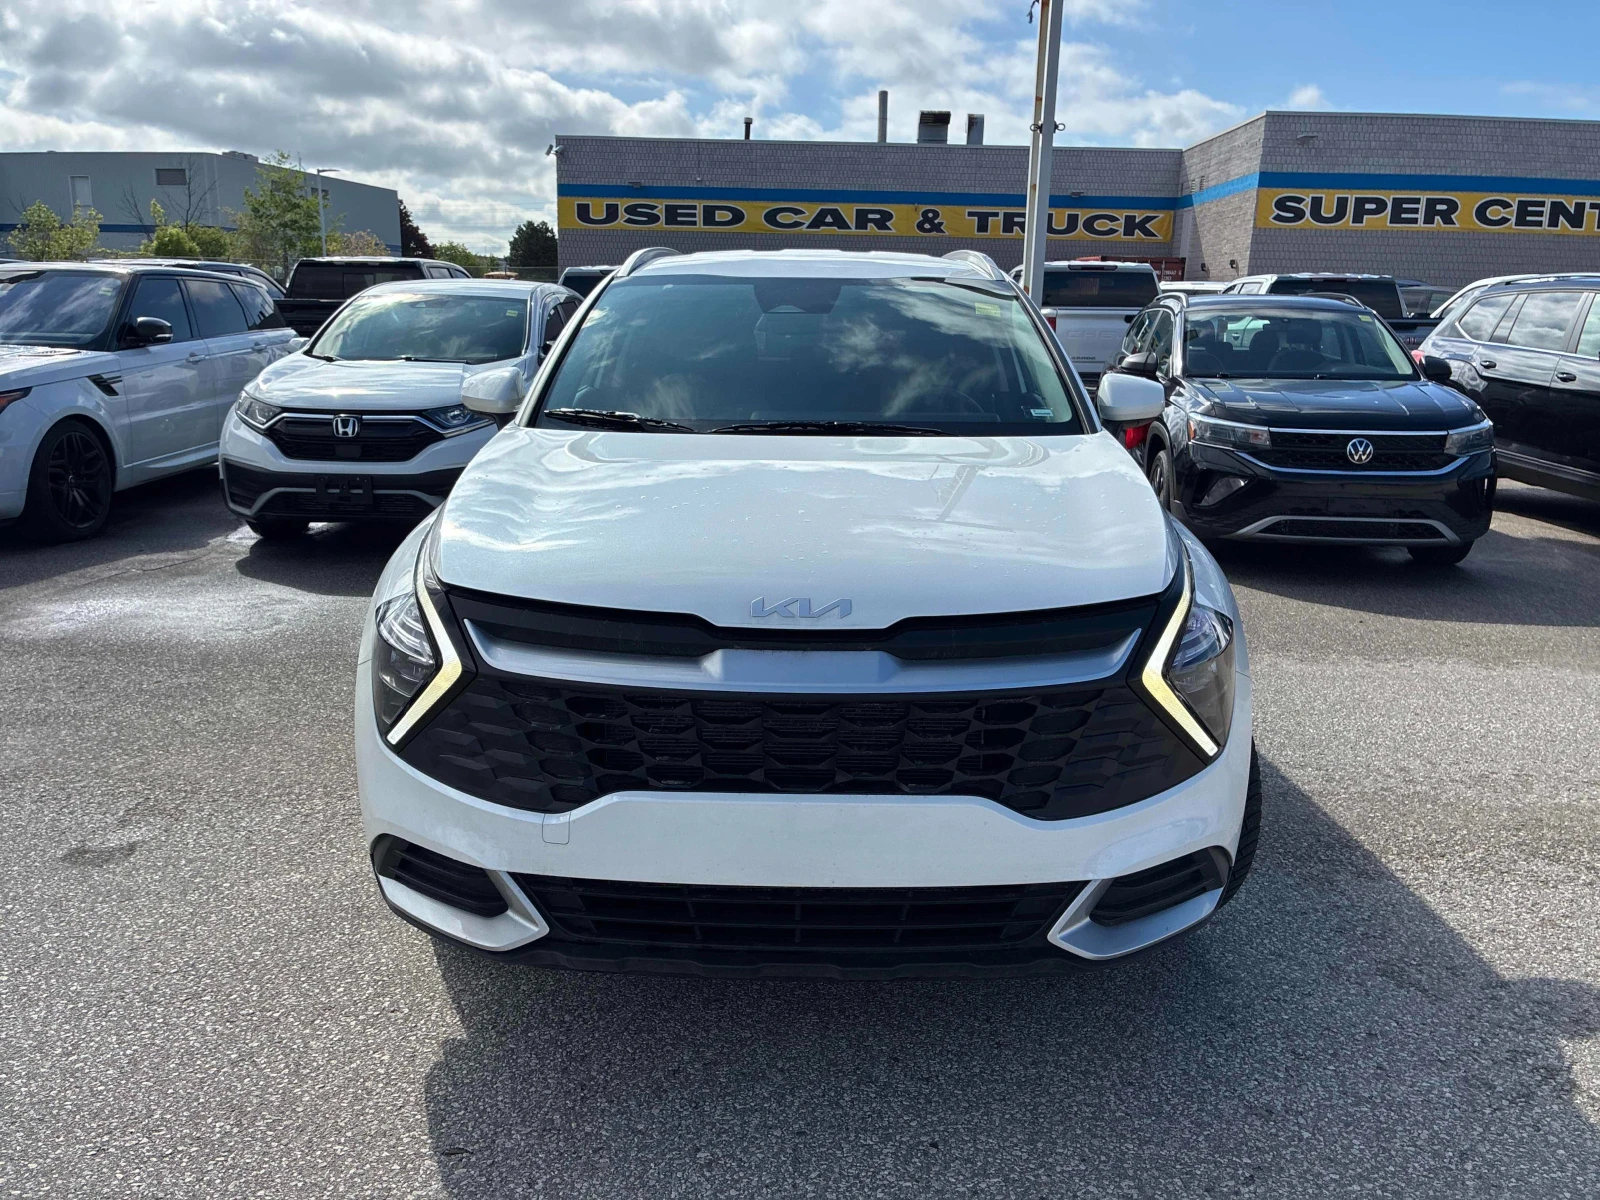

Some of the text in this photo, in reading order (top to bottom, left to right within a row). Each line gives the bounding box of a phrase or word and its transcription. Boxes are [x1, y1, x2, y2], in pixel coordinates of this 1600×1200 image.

[575, 202, 1163, 239] USED CAR & TRUCK
[1269, 194, 1460, 227] SUPER
[750, 596, 852, 619] KIA
